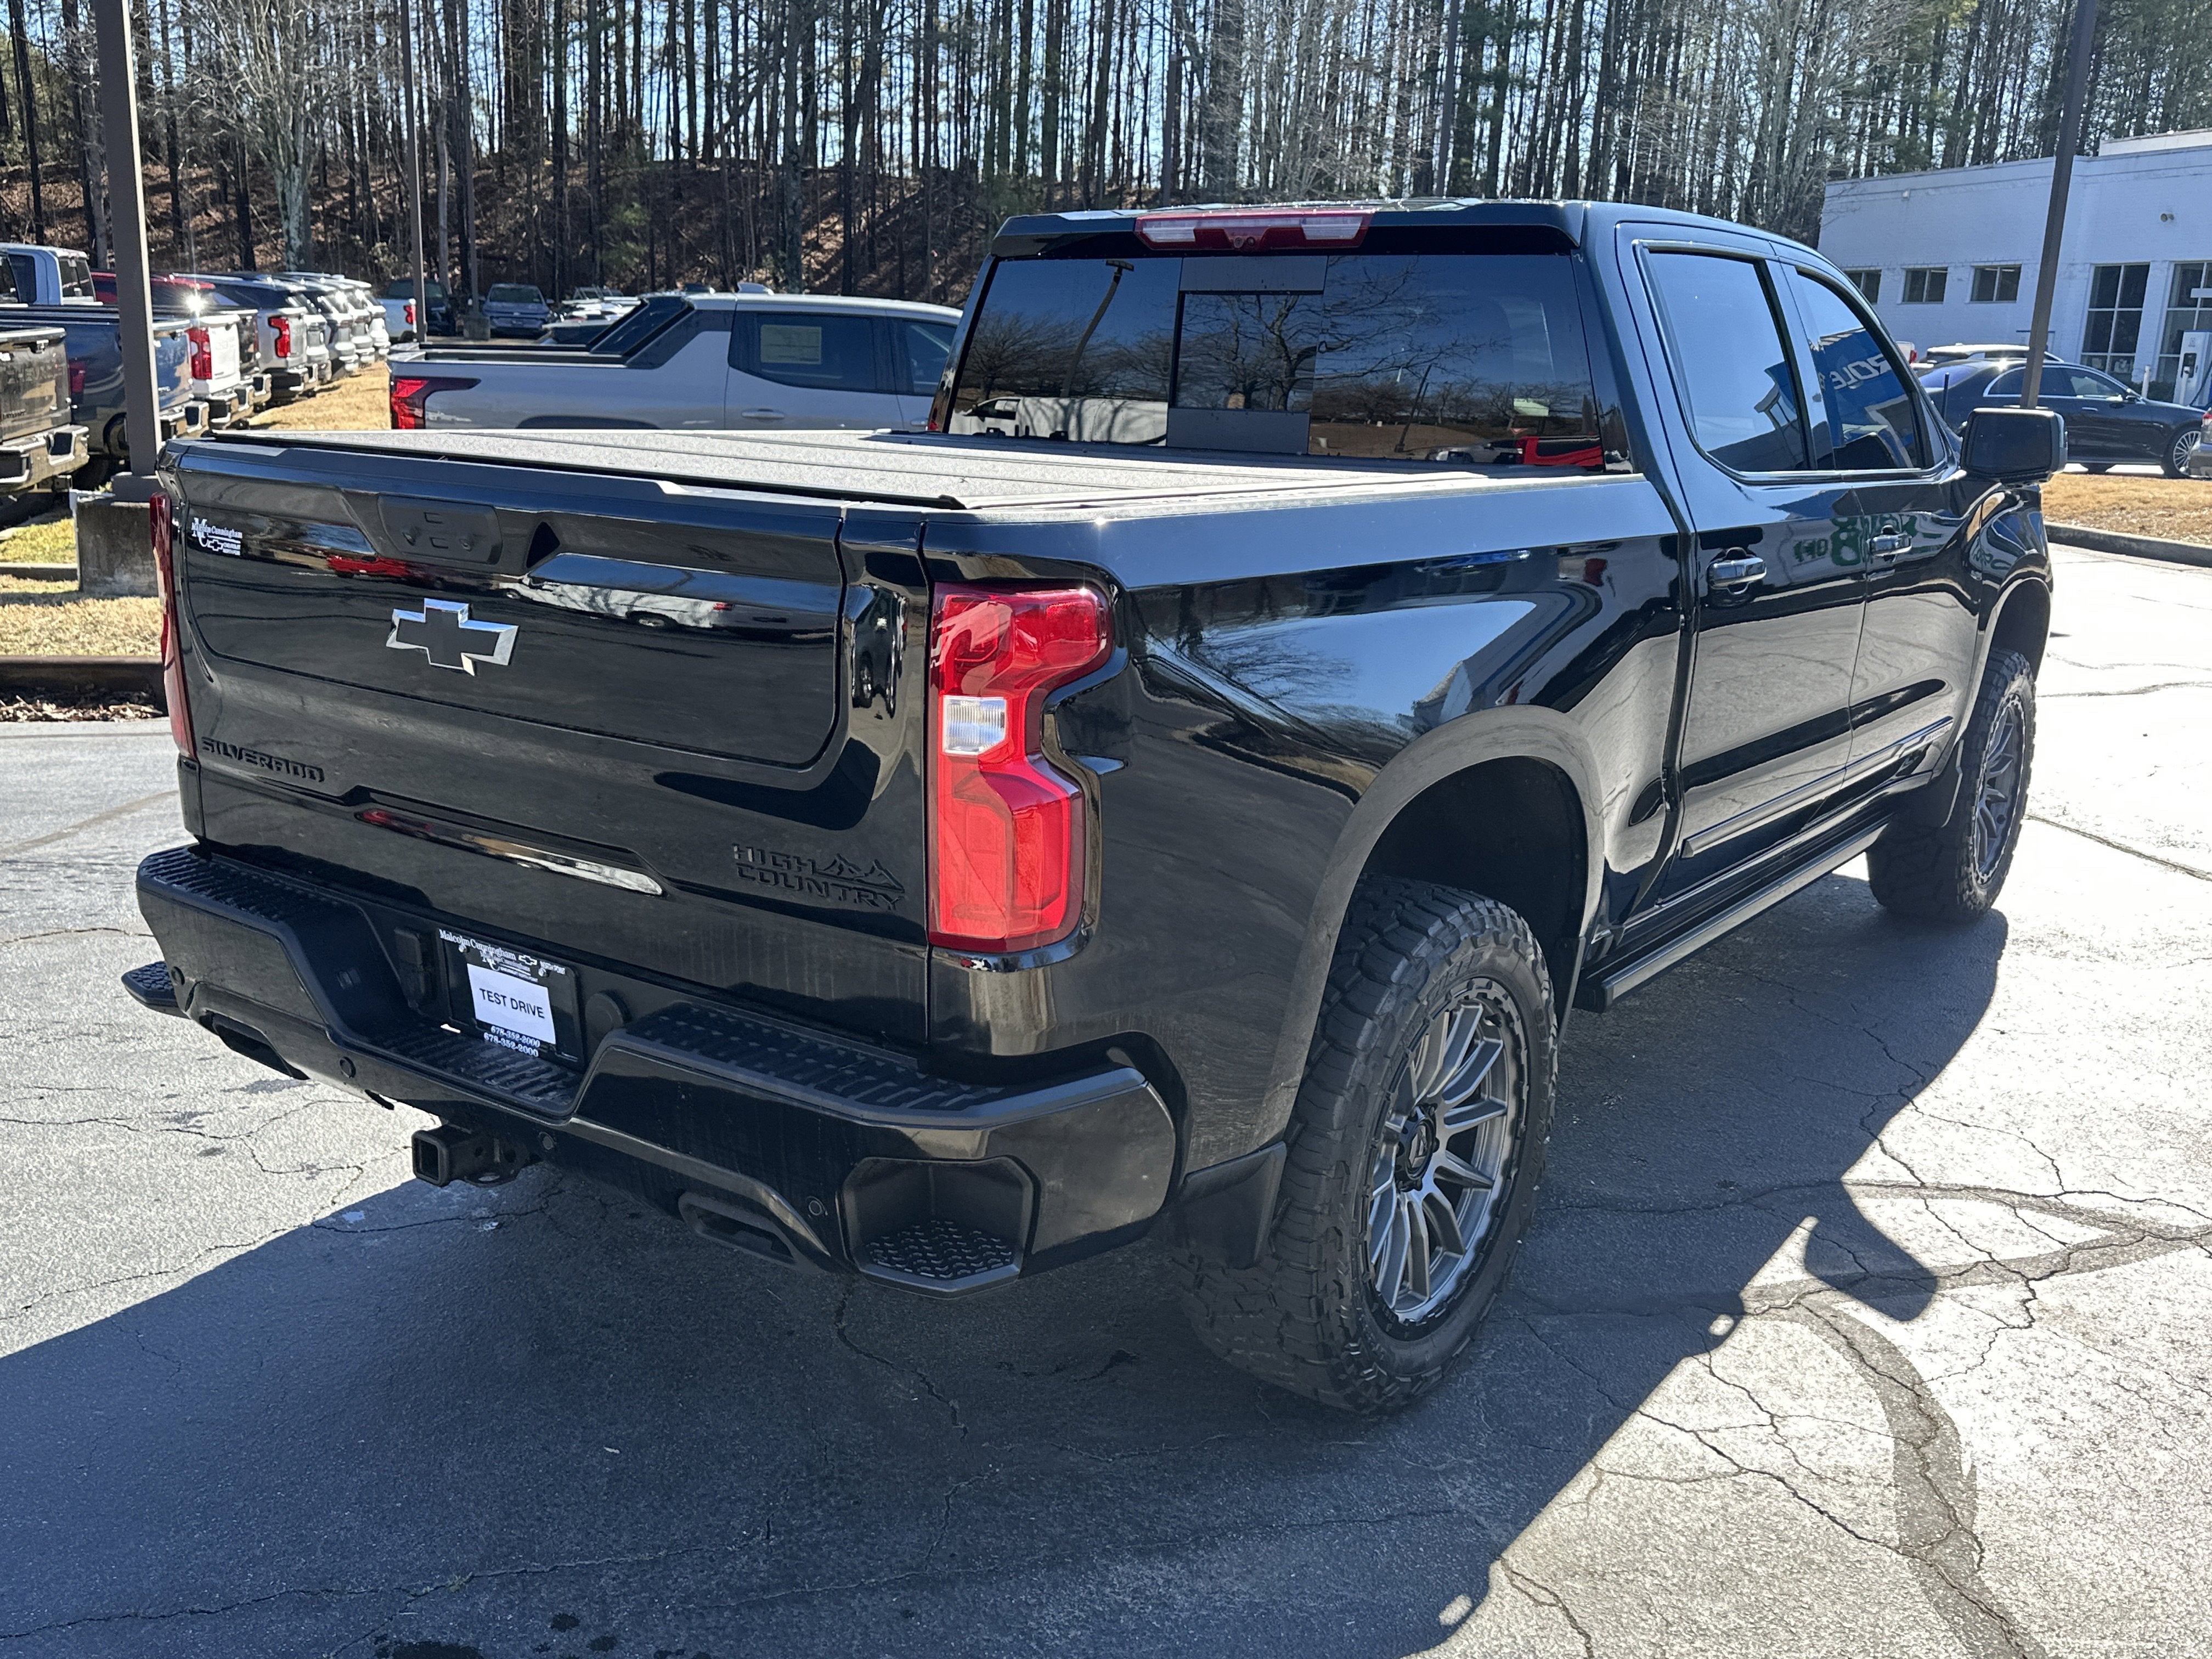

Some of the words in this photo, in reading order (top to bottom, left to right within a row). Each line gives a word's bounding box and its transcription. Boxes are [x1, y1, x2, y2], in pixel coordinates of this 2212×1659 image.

[201, 736, 325, 783] SILVERADO
[732, 843, 816, 875] HIGH
[736, 862, 904, 910] COUNTRY
[439, 929, 471, 947] Malcolm
[470, 939, 517, 961] Cunningham
[479, 988, 507, 1007] TEST
[510, 997, 545, 1019] DRIVE
